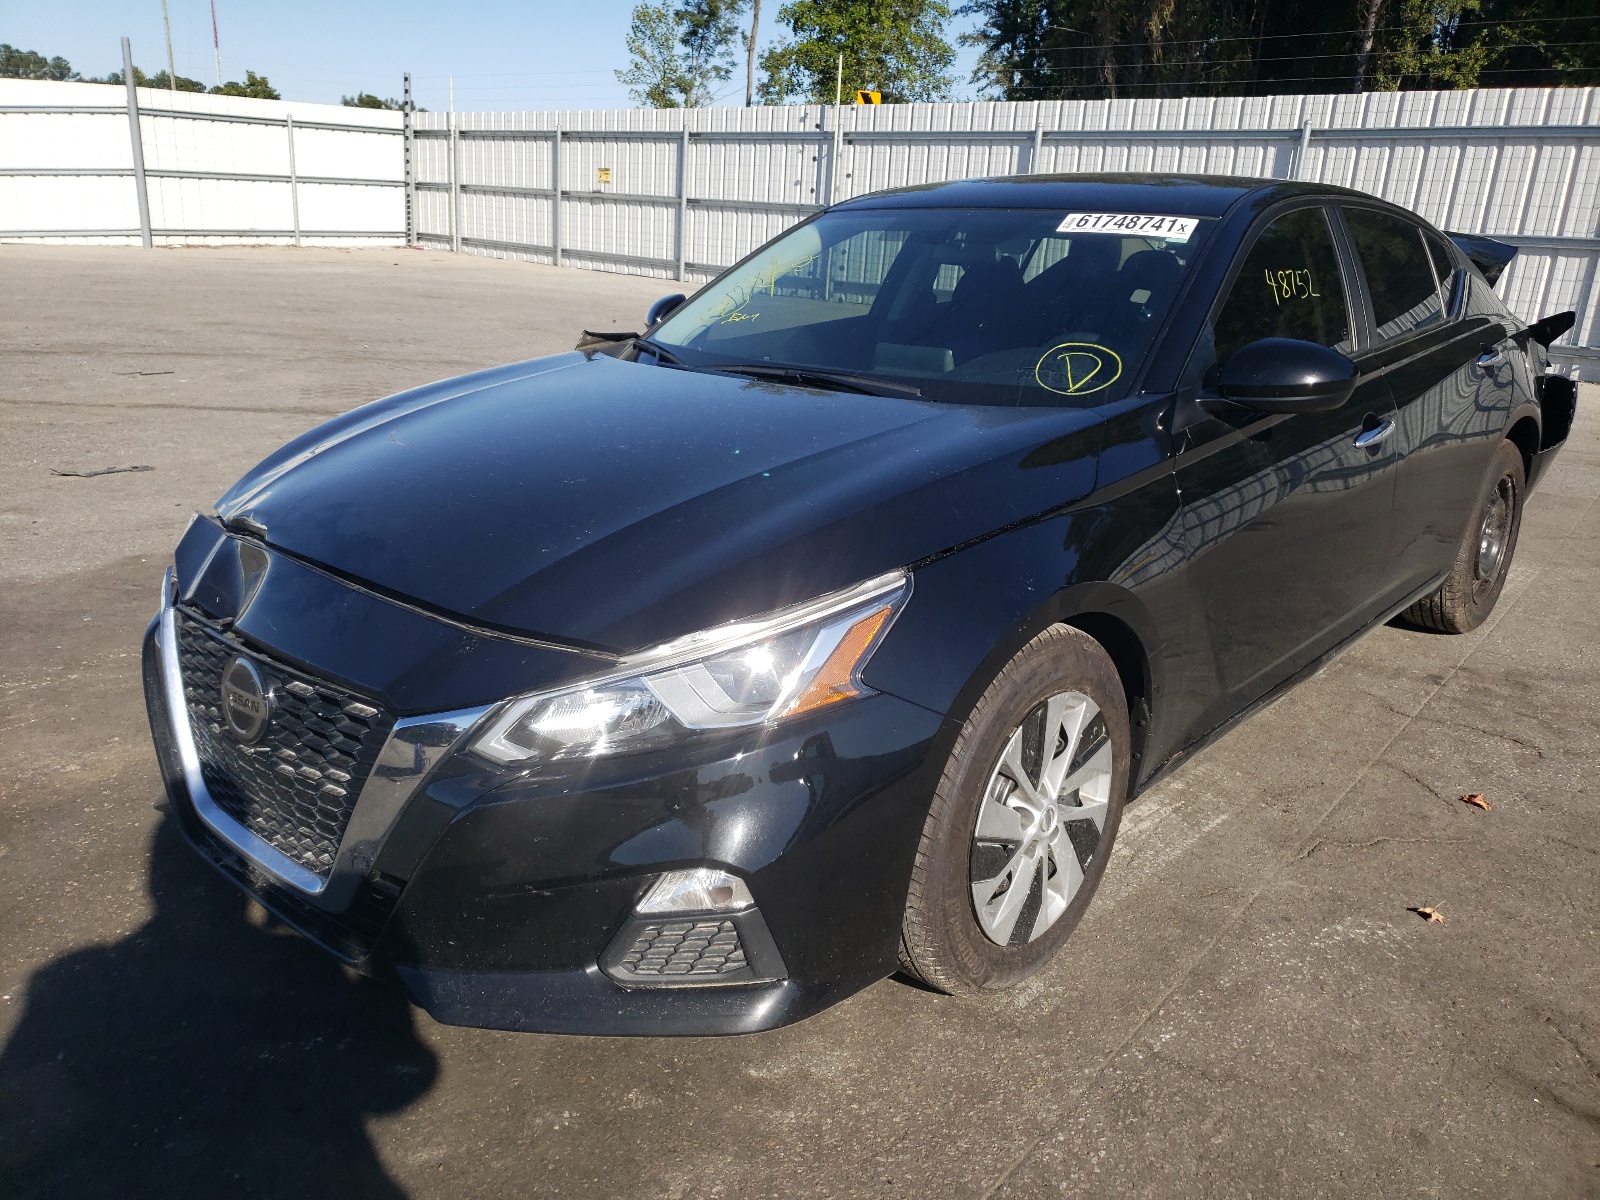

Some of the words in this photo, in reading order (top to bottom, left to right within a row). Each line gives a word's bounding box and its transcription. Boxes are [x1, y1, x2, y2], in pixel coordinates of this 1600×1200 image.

[1265, 268, 1321, 306] 48752
[1057, 352, 1102, 393] D
[224, 684, 261, 714] SSAN
